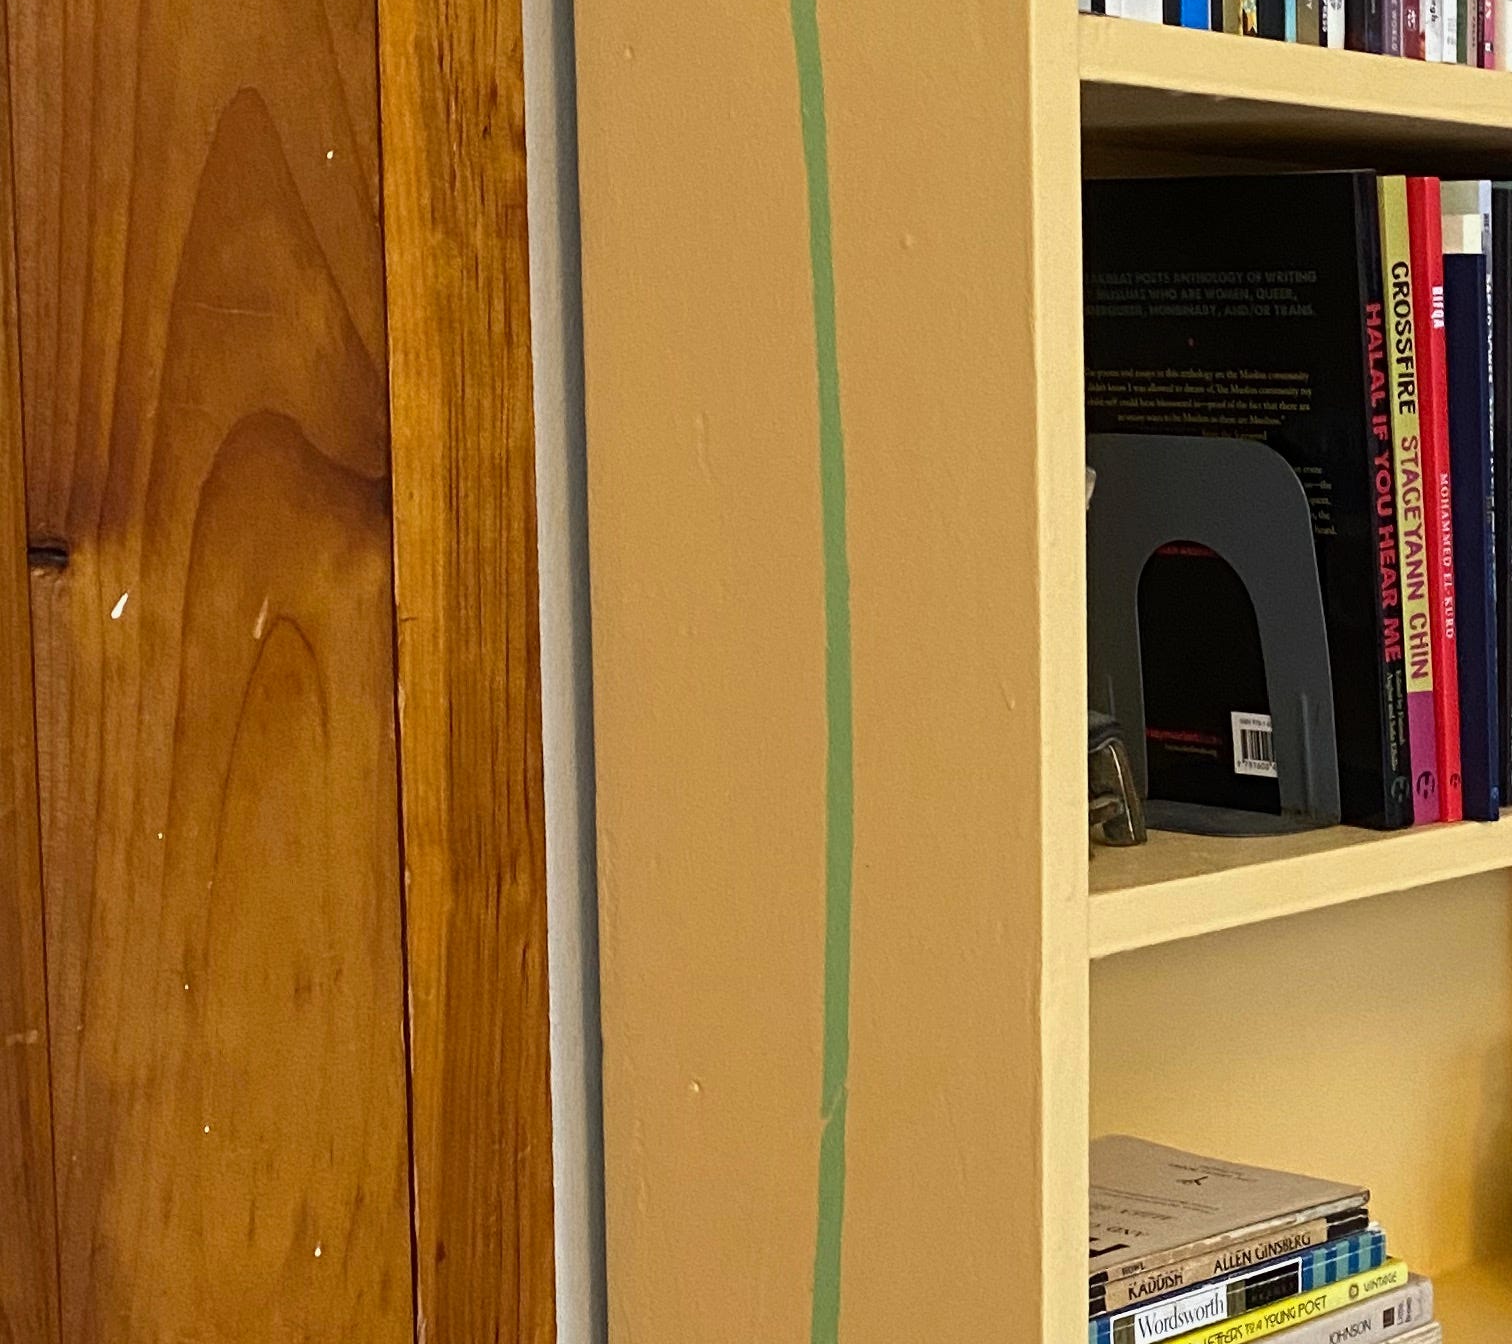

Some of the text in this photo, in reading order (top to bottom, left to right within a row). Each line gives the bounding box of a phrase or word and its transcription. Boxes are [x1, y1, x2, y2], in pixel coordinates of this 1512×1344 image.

[1365, 303, 1401, 663] HALAL IF YOU HEAR ME
[1392, 261, 1430, 680] CROSSFIRE STACEYANN CHIN
[1129, 1233, 1311, 1300] KADDISH ALLEN GINSBERG
[1364, 1272, 1397, 1291] VINTAGE
[1138, 1287, 1225, 1338] Wordsworth
